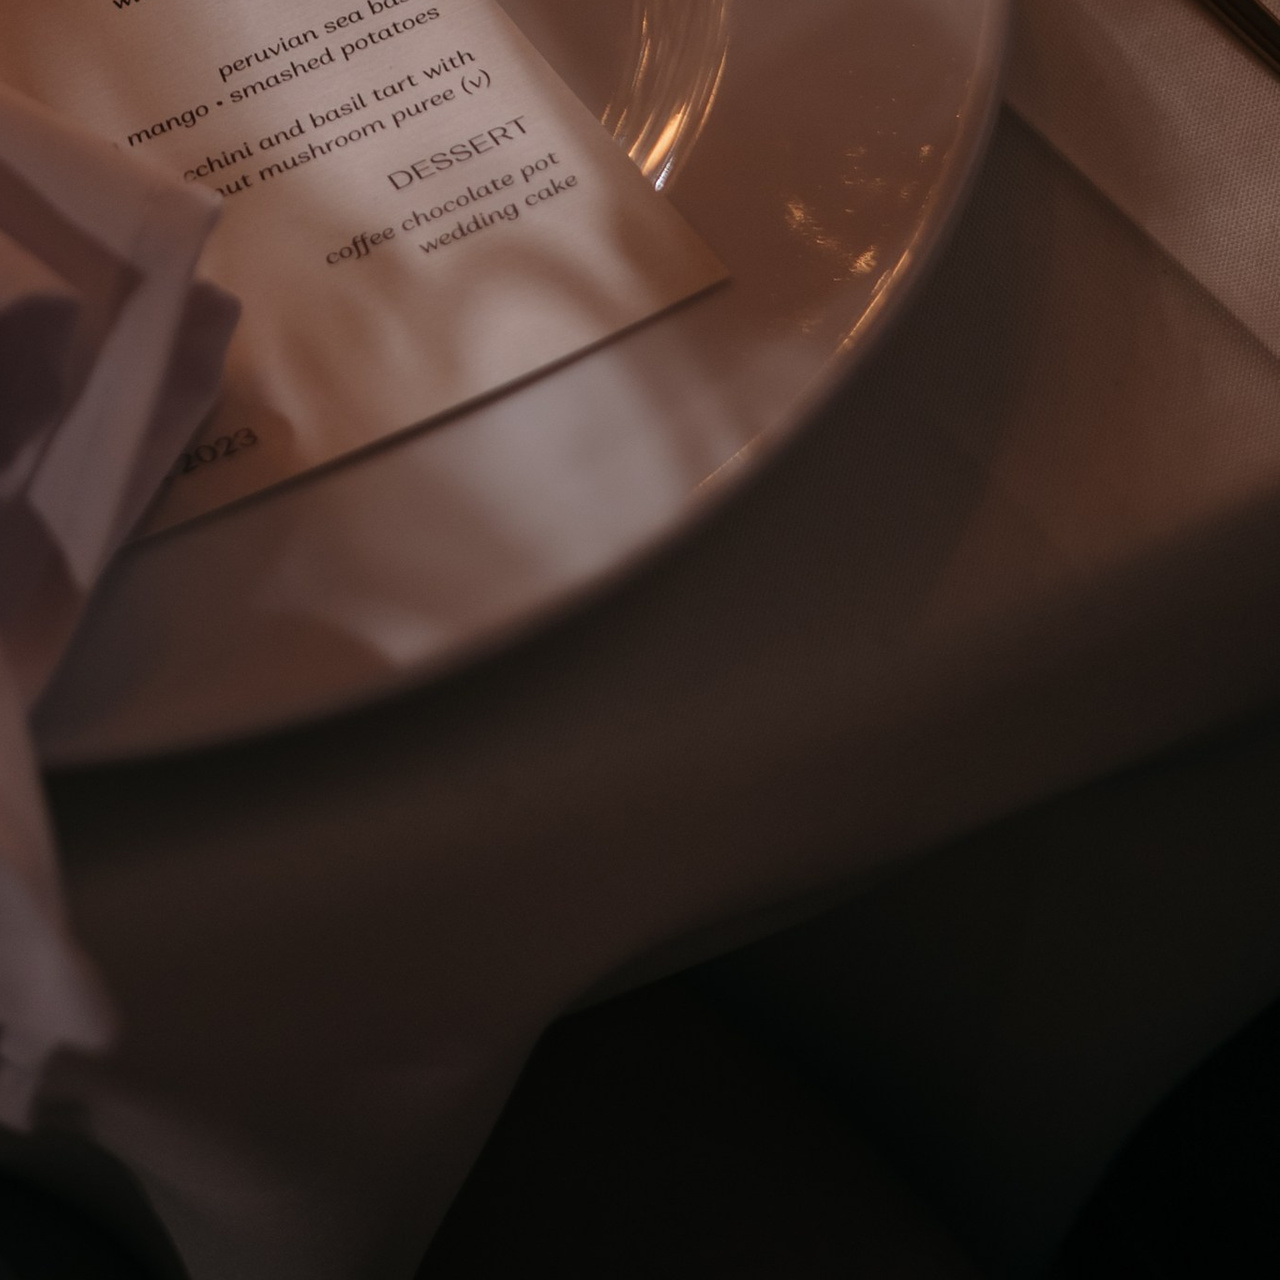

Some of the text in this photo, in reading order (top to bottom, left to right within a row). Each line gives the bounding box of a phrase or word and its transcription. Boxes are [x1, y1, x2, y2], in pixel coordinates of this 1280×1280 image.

[127, 6, 441, 147] mango smashed potatoes
[218, 28, 320, 83] peruvian
[323, 9, 365, 34] sea
[258, 118, 386, 181] mushroom
[391, 87, 456, 128] puree
[460, 68, 492, 96] (v)
[259, 119, 306, 151] and
[308, 93, 368, 129] basil
[371, 73, 419, 102] tart
[422, 49, 476, 80] with
[386, 115, 529, 190] DESSERT
[325, 151, 560, 265] coffee chocolate pot
[418, 172, 579, 254] wedding cake
[181, 426, 258, 474] 2023
